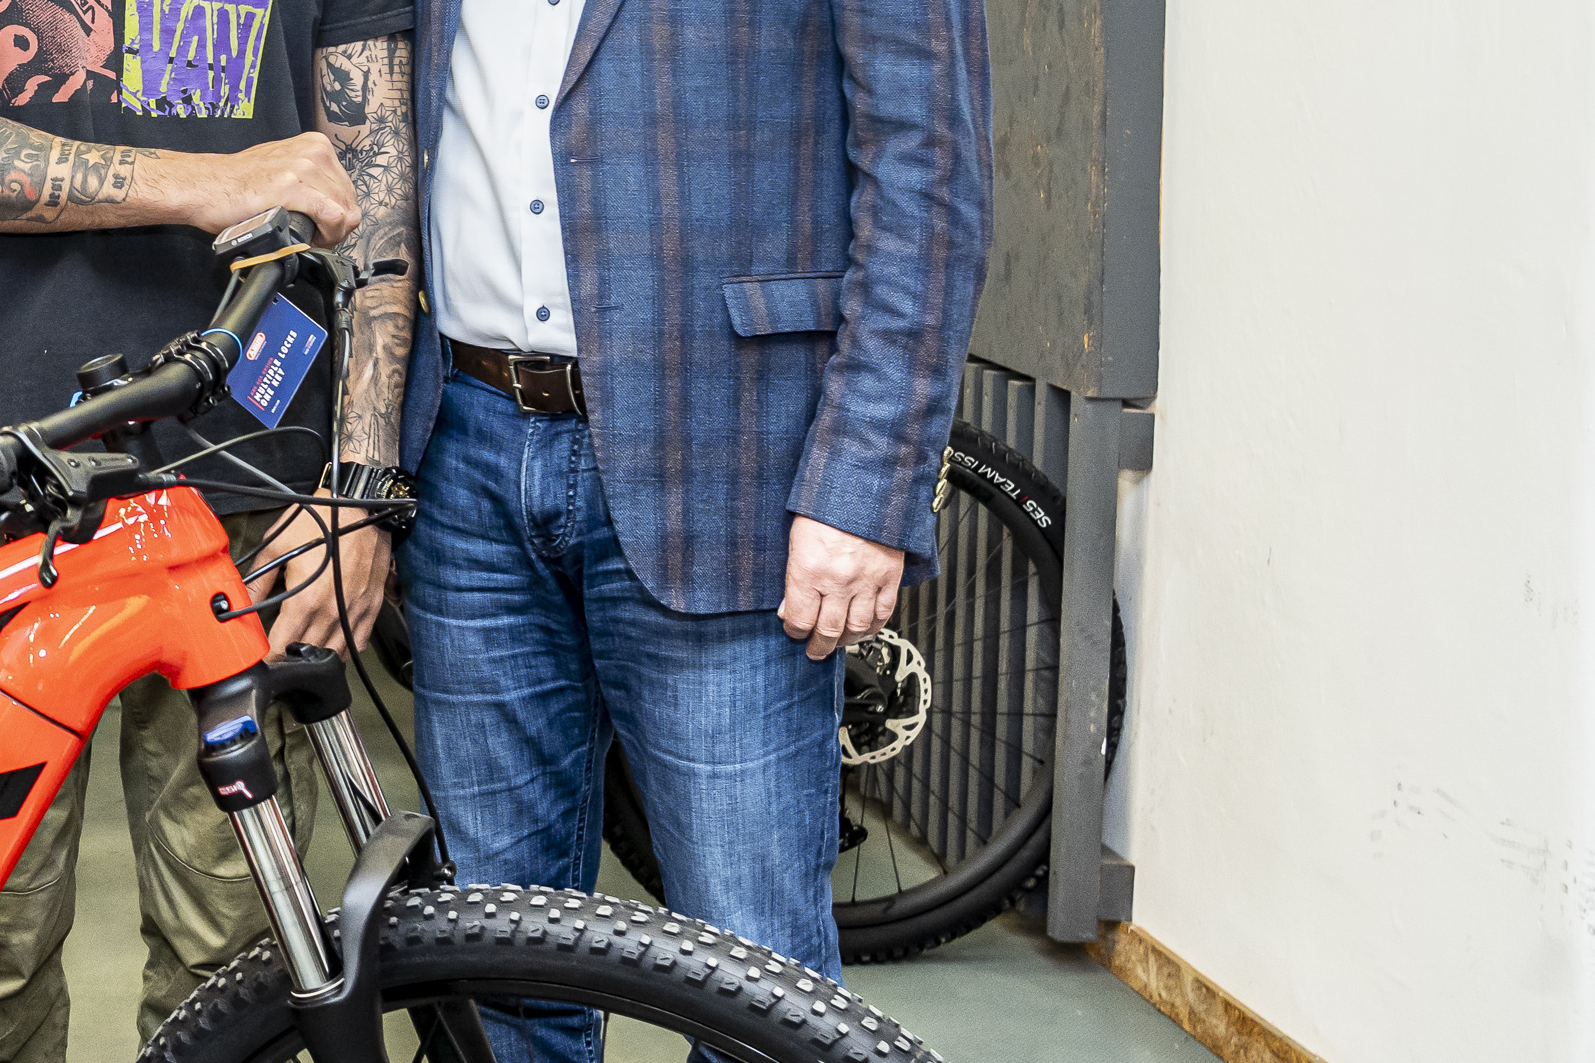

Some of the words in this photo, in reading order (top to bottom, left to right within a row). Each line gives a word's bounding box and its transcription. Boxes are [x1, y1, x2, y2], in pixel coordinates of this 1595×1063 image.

[253, 358, 282, 401] MULTIPLE
[277, 330, 298, 359] LOCKS
[260, 389, 275, 407] ONE
[272, 367, 286, 387] KEY
[977, 464, 1021, 500] TEAM
